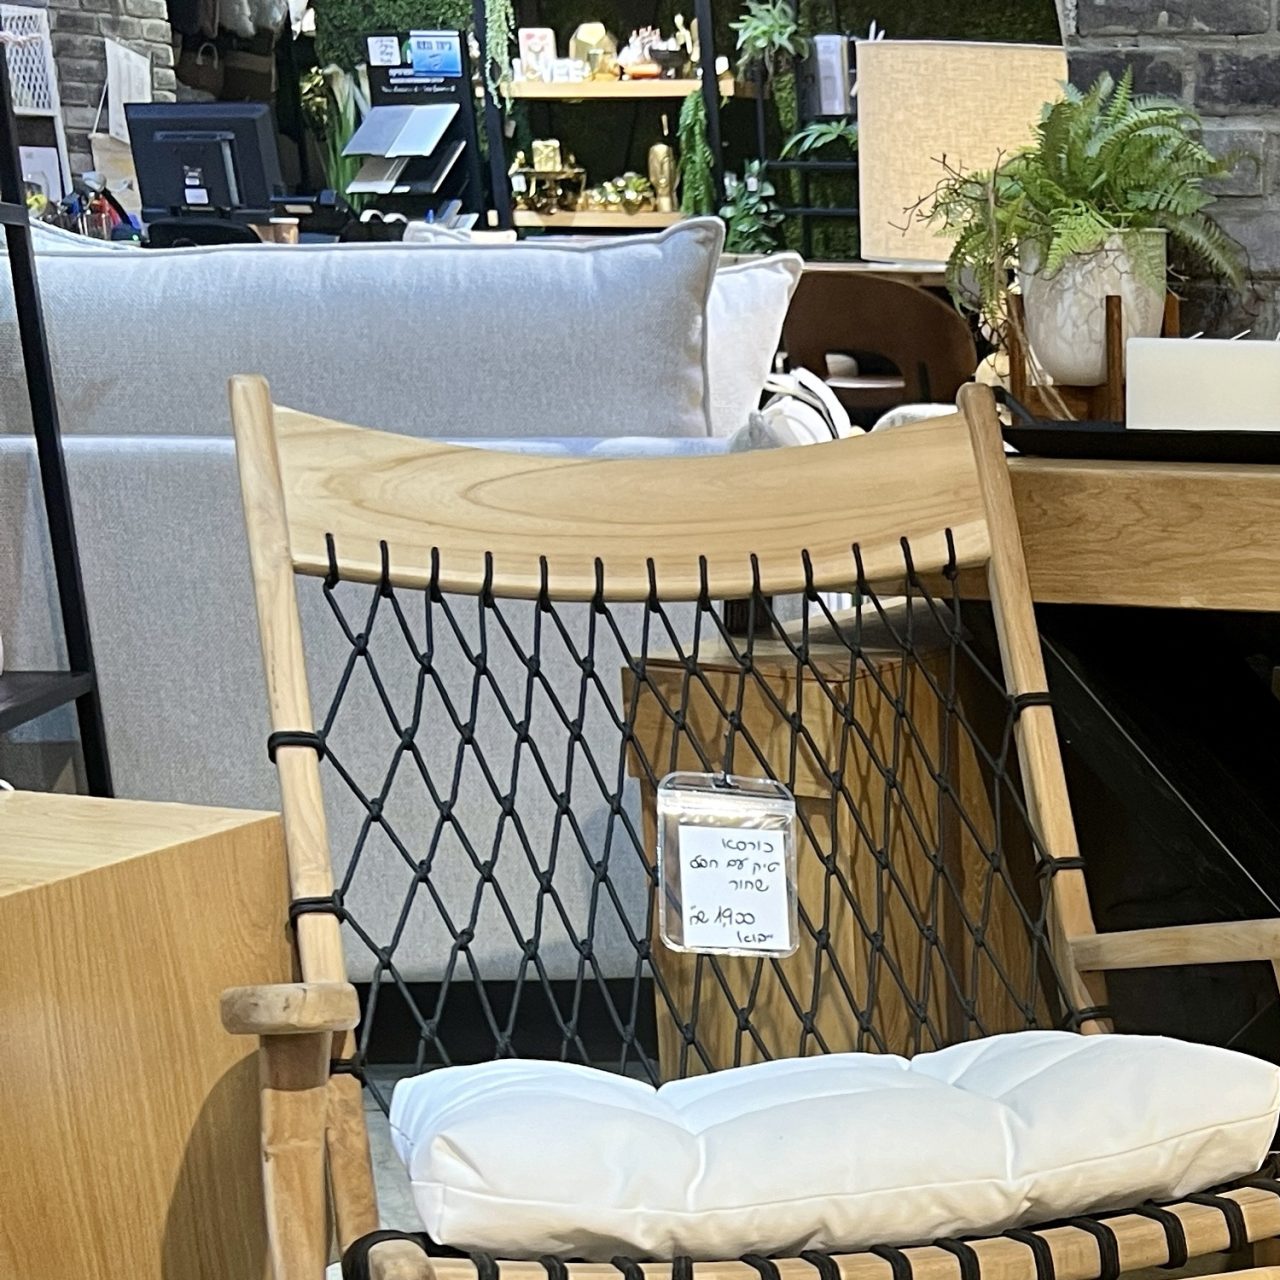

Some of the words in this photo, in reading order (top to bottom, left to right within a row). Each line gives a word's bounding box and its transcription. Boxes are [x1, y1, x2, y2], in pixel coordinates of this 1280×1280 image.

[721, 838, 774, 853] כורסא
[726, 857, 750, 870] עם
[752, 861, 780, 876] טיק
[728, 878, 769, 892] שחור
[714, 905, 756, 928] 1,900
[736, 930, 774, 943] יבוא
